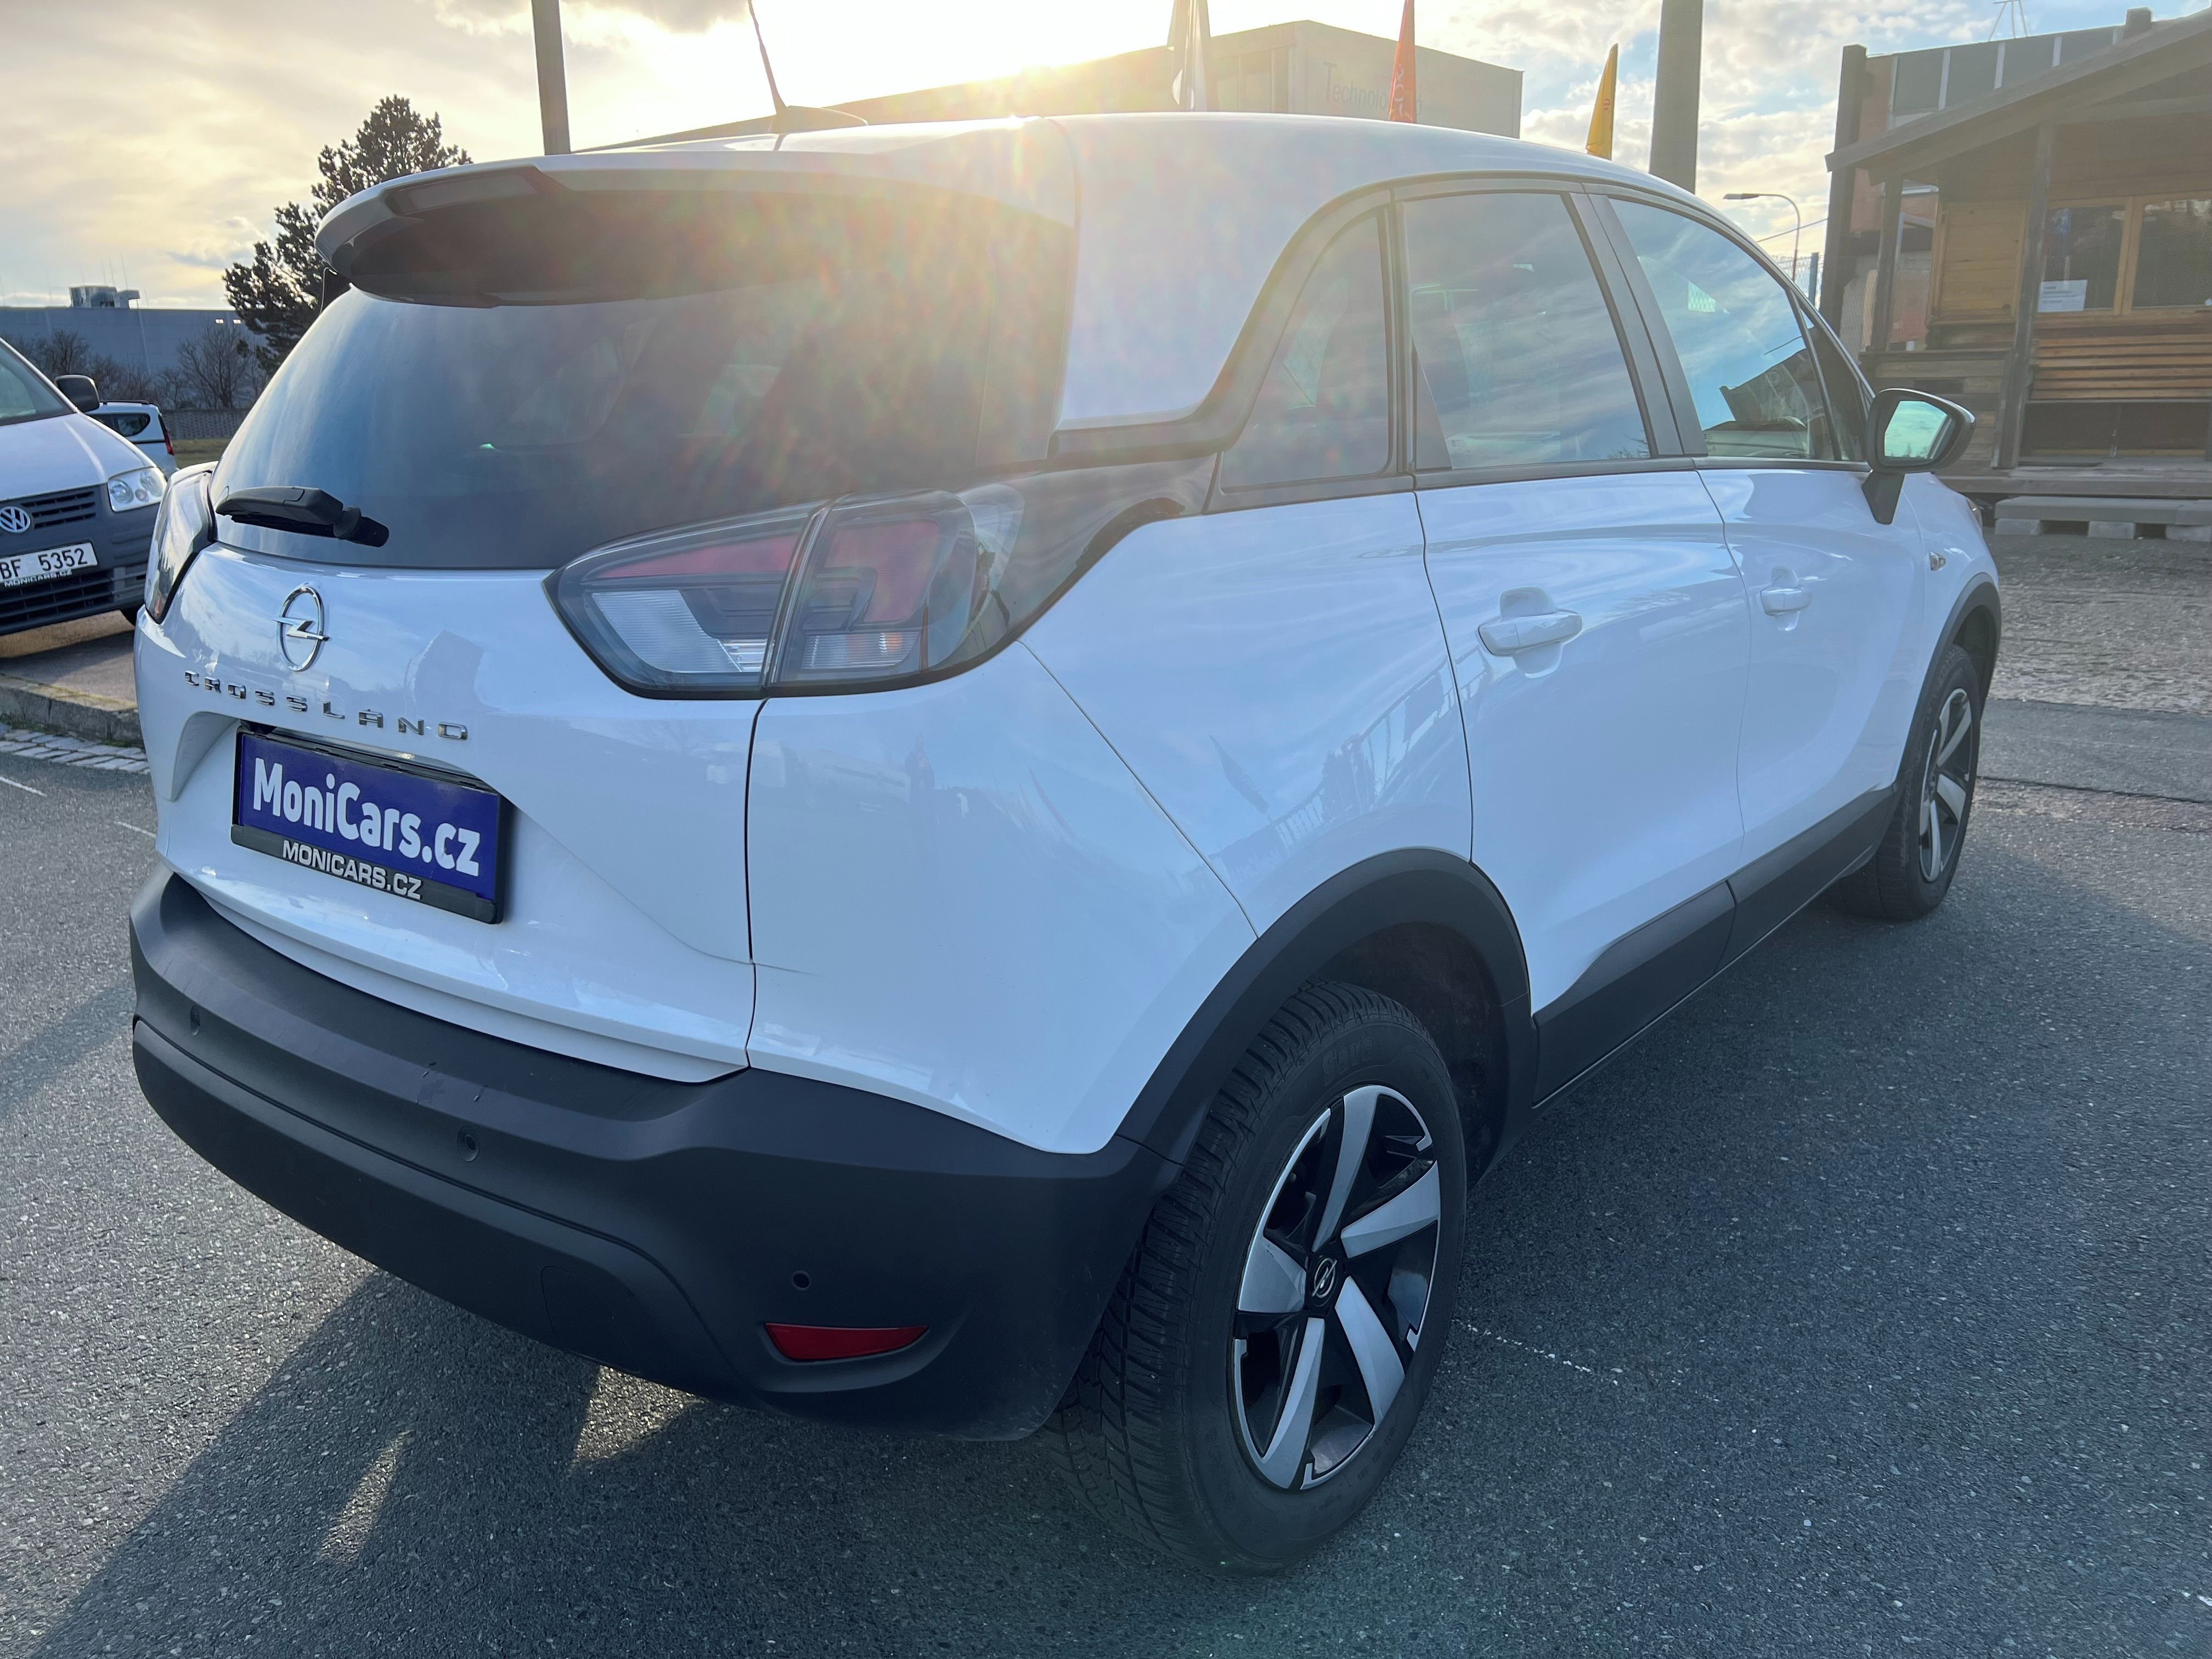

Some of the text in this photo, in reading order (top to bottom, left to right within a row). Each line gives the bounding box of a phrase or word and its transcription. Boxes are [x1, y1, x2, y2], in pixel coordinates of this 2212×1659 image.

[4, 569, 73, 588] MONICARS.CZ
[38, 548, 88, 571] 5352
[184, 670, 469, 740] CROSSLAND
[283, 840, 422, 900] MONICARS.CZ
